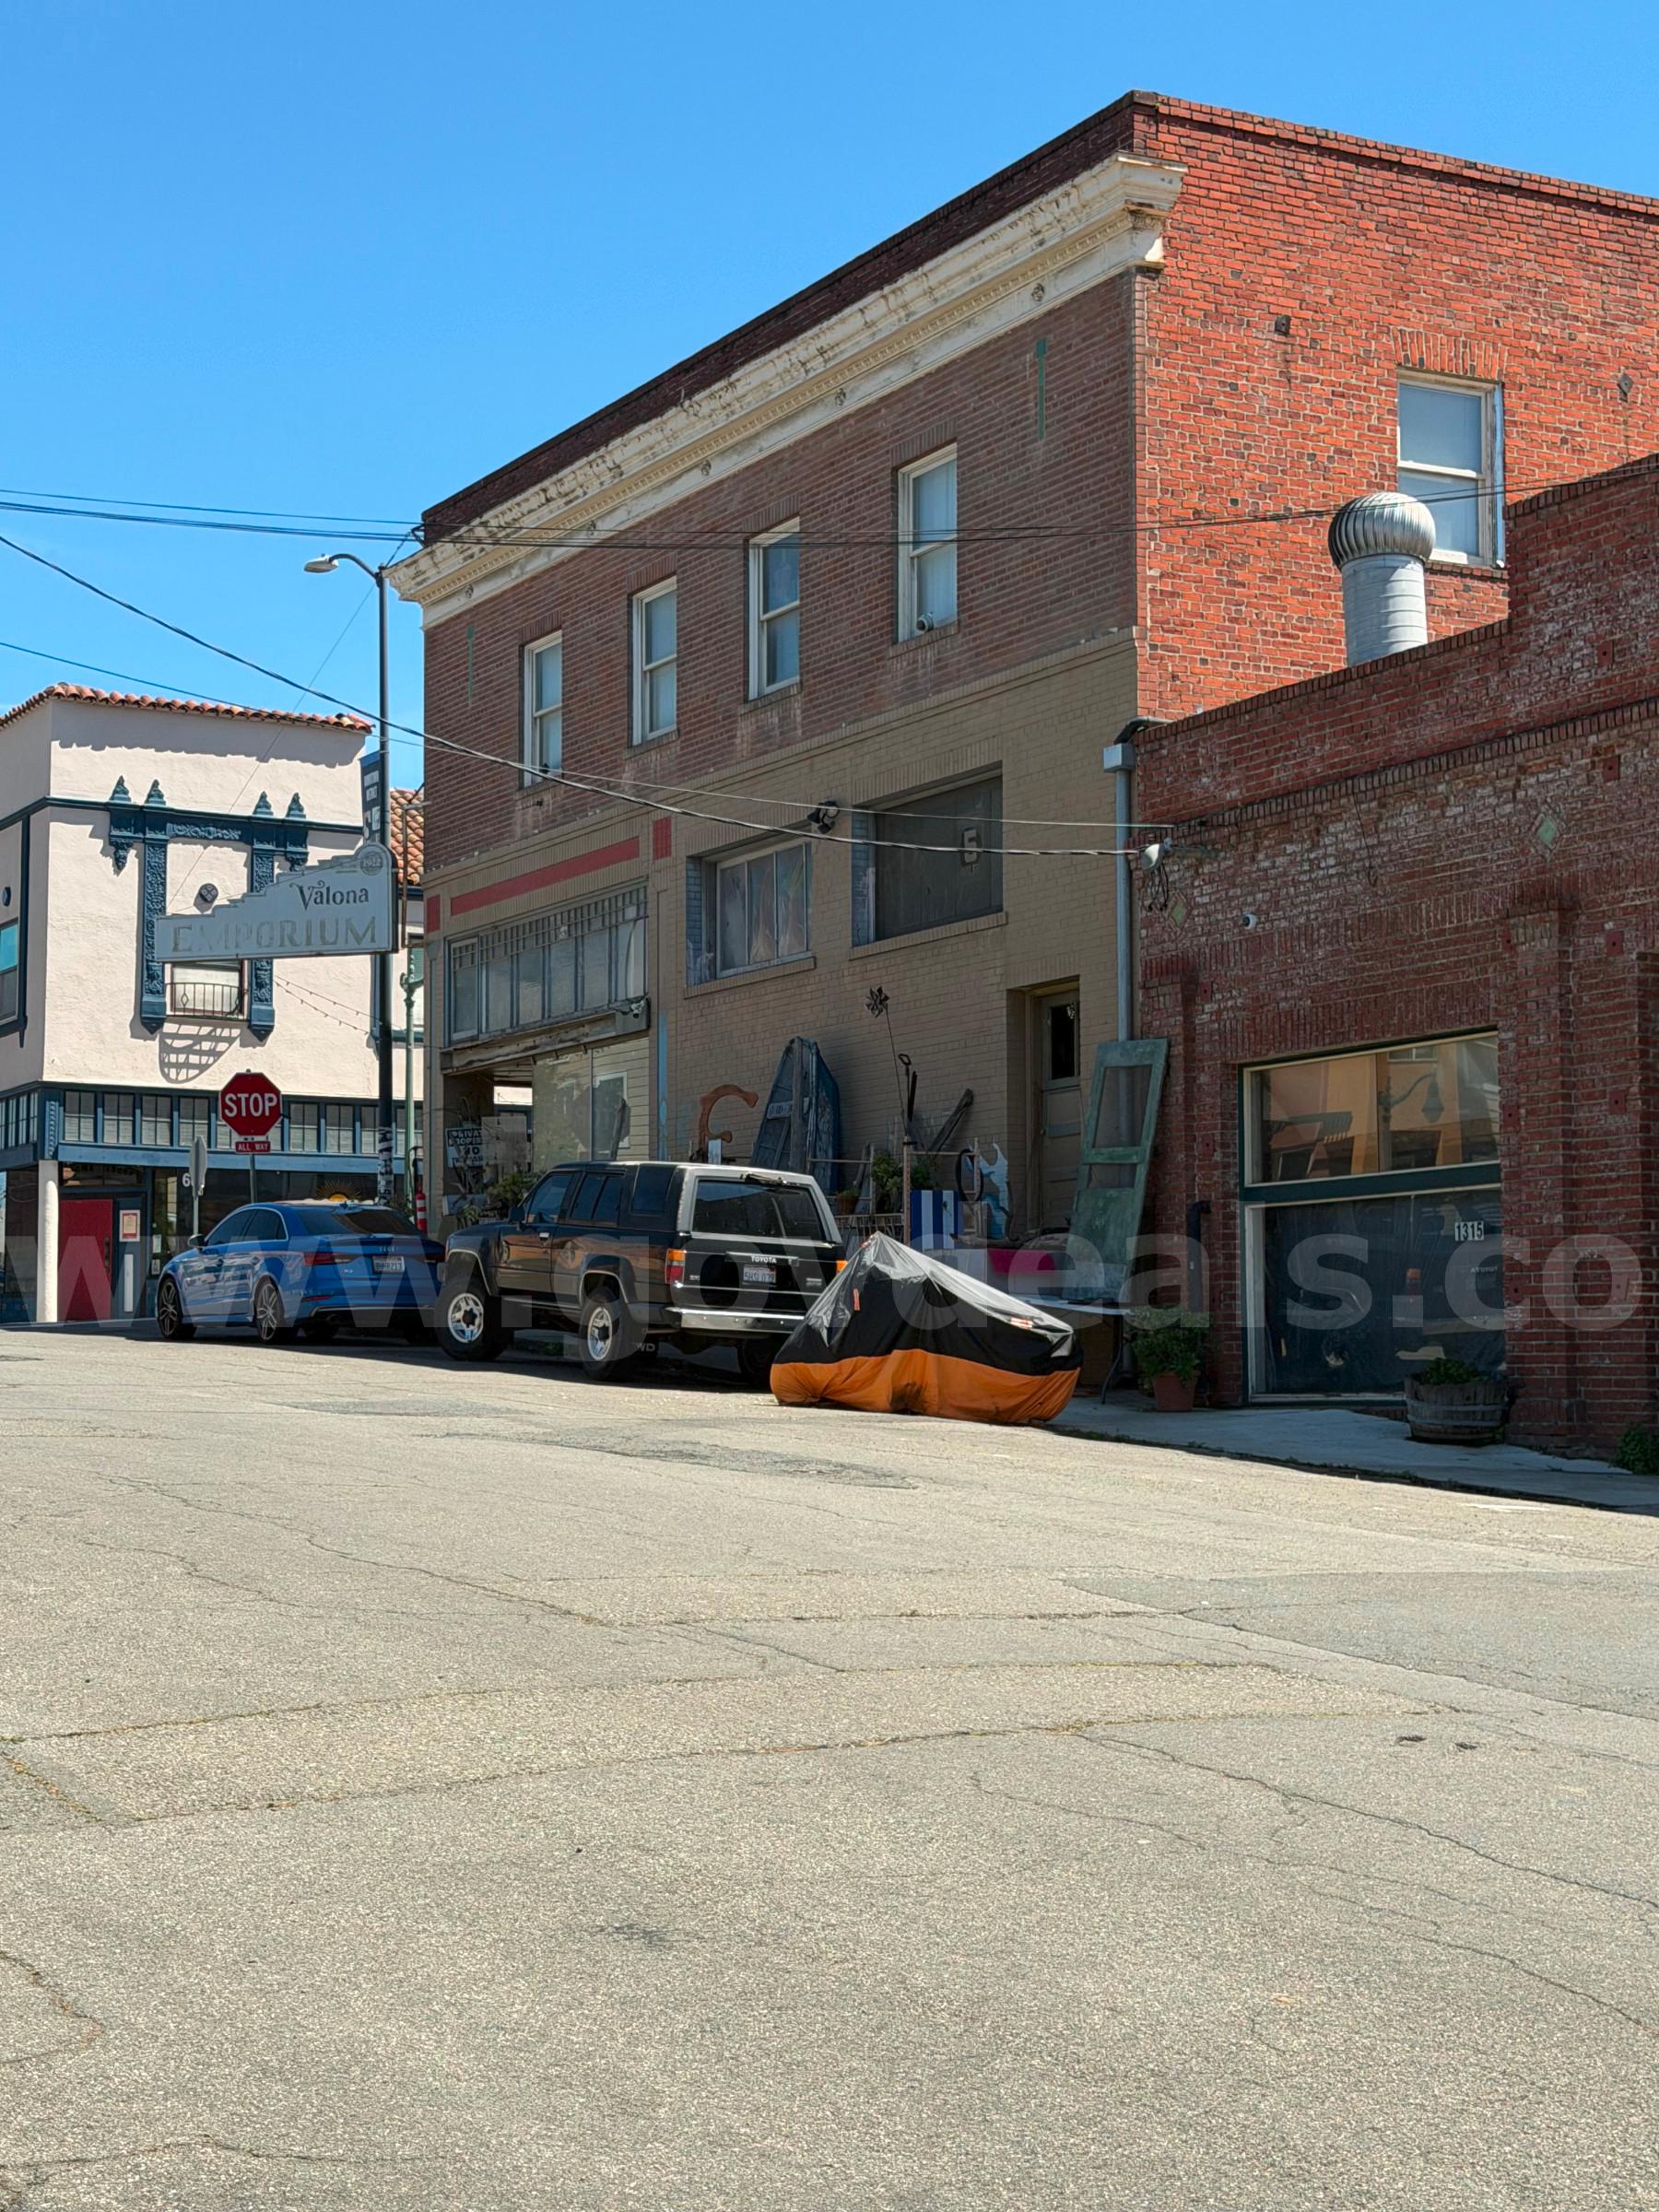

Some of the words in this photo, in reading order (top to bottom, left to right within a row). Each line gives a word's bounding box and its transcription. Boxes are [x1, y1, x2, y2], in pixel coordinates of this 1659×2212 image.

[289, 879, 369, 911] Valona
[172, 916, 377, 953] EMPORIUM
[224, 1092, 277, 1117] STOP
[1456, 1223, 1483, 1241] 1315
[751, 1254, 777, 1264] TOYOTA
